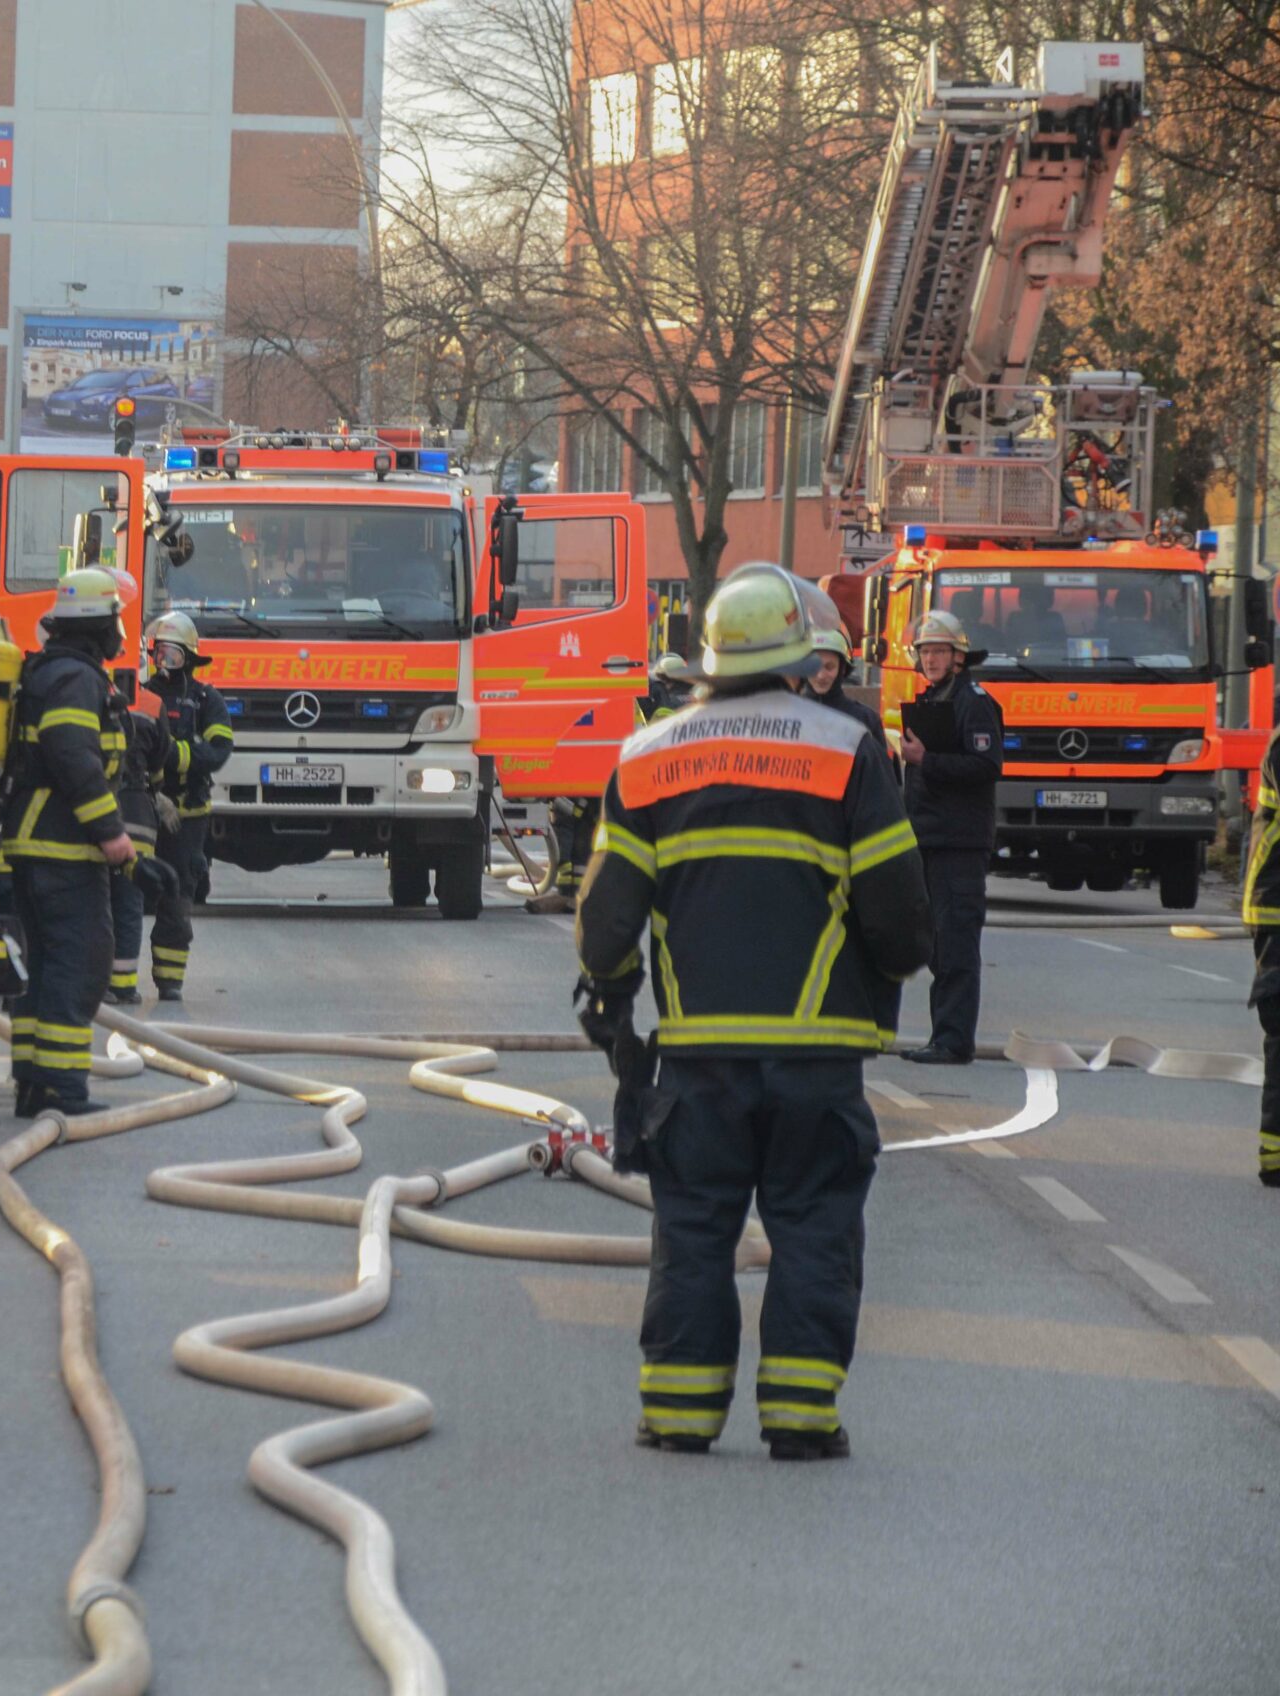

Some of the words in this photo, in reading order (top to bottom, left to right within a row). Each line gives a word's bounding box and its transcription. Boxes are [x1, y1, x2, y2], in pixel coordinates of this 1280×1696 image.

[37, 327, 57, 337] DER
[59, 328, 83, 338] NEUE
[85, 329, 112, 340] FORD
[114, 330, 149, 341] FOCUS
[1009, 692, 1136, 714] FEUERWEHR
[733, 751, 813, 782] HAMBURG
[276, 767, 294, 781] HH
[302, 767, 336, 781] 2522
[1046, 791, 1062, 805] HH
[1070, 792, 1099, 805] 2721
